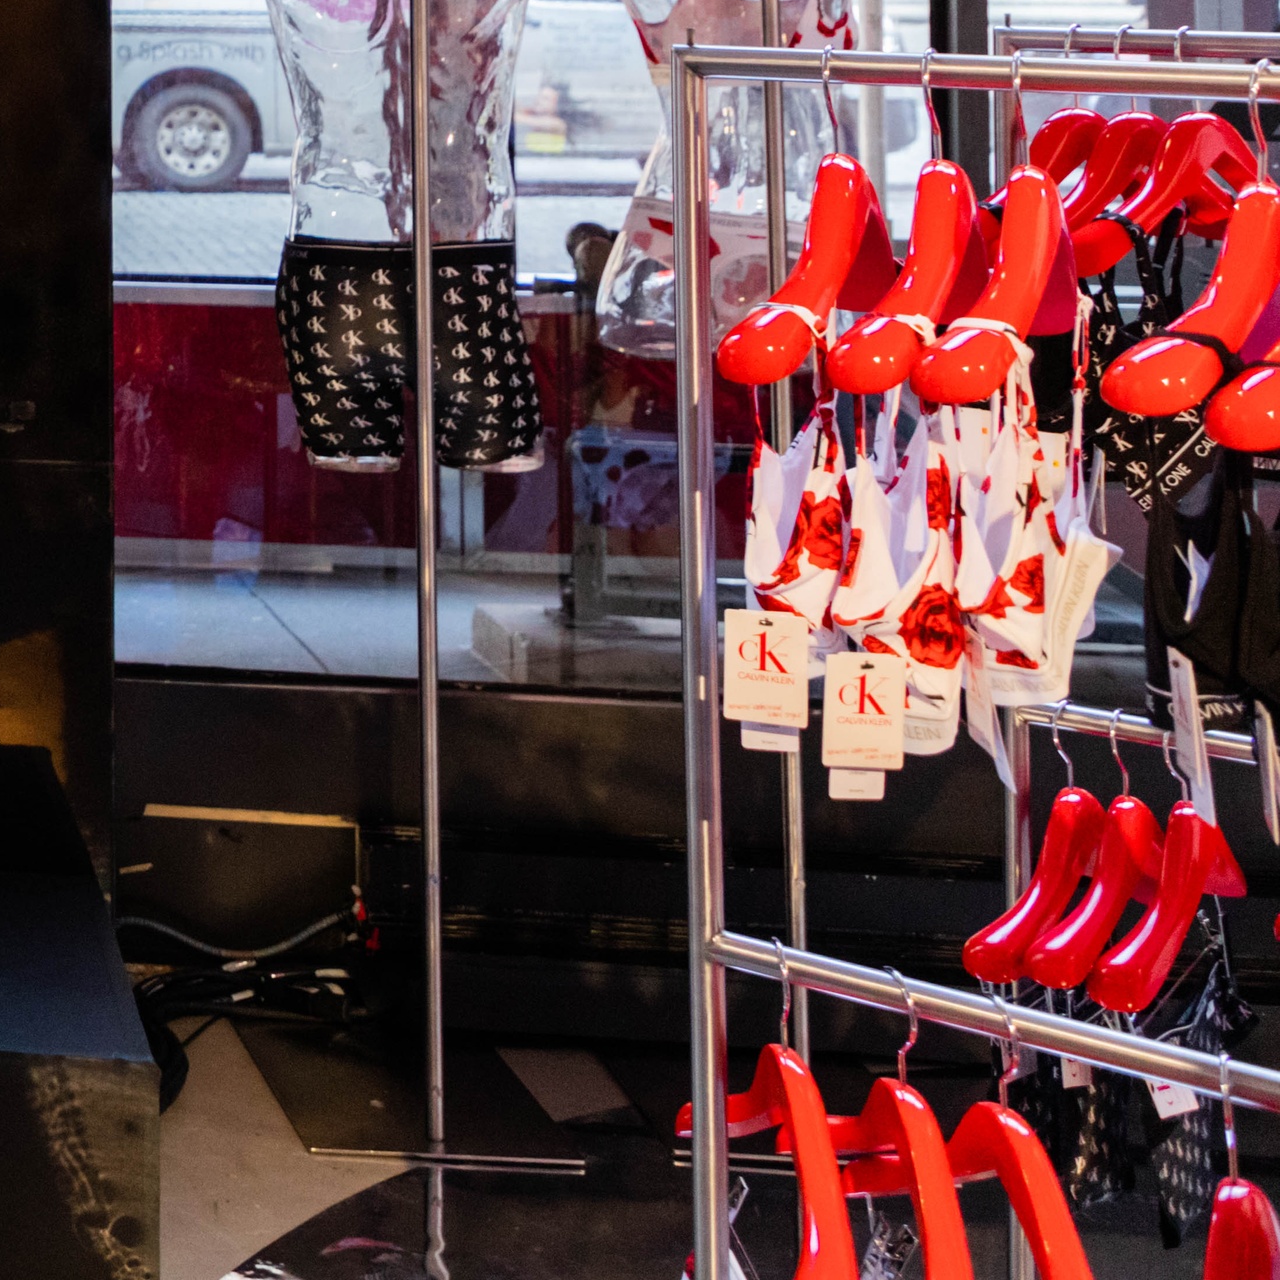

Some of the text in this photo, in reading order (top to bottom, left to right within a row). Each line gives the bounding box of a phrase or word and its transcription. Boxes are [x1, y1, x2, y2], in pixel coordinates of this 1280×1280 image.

[1194, 434, 1219, 458] CAL
[737, 671, 795, 686] CALVIN KLEIN
[836, 716, 893, 726] CALVIN KLEIN
